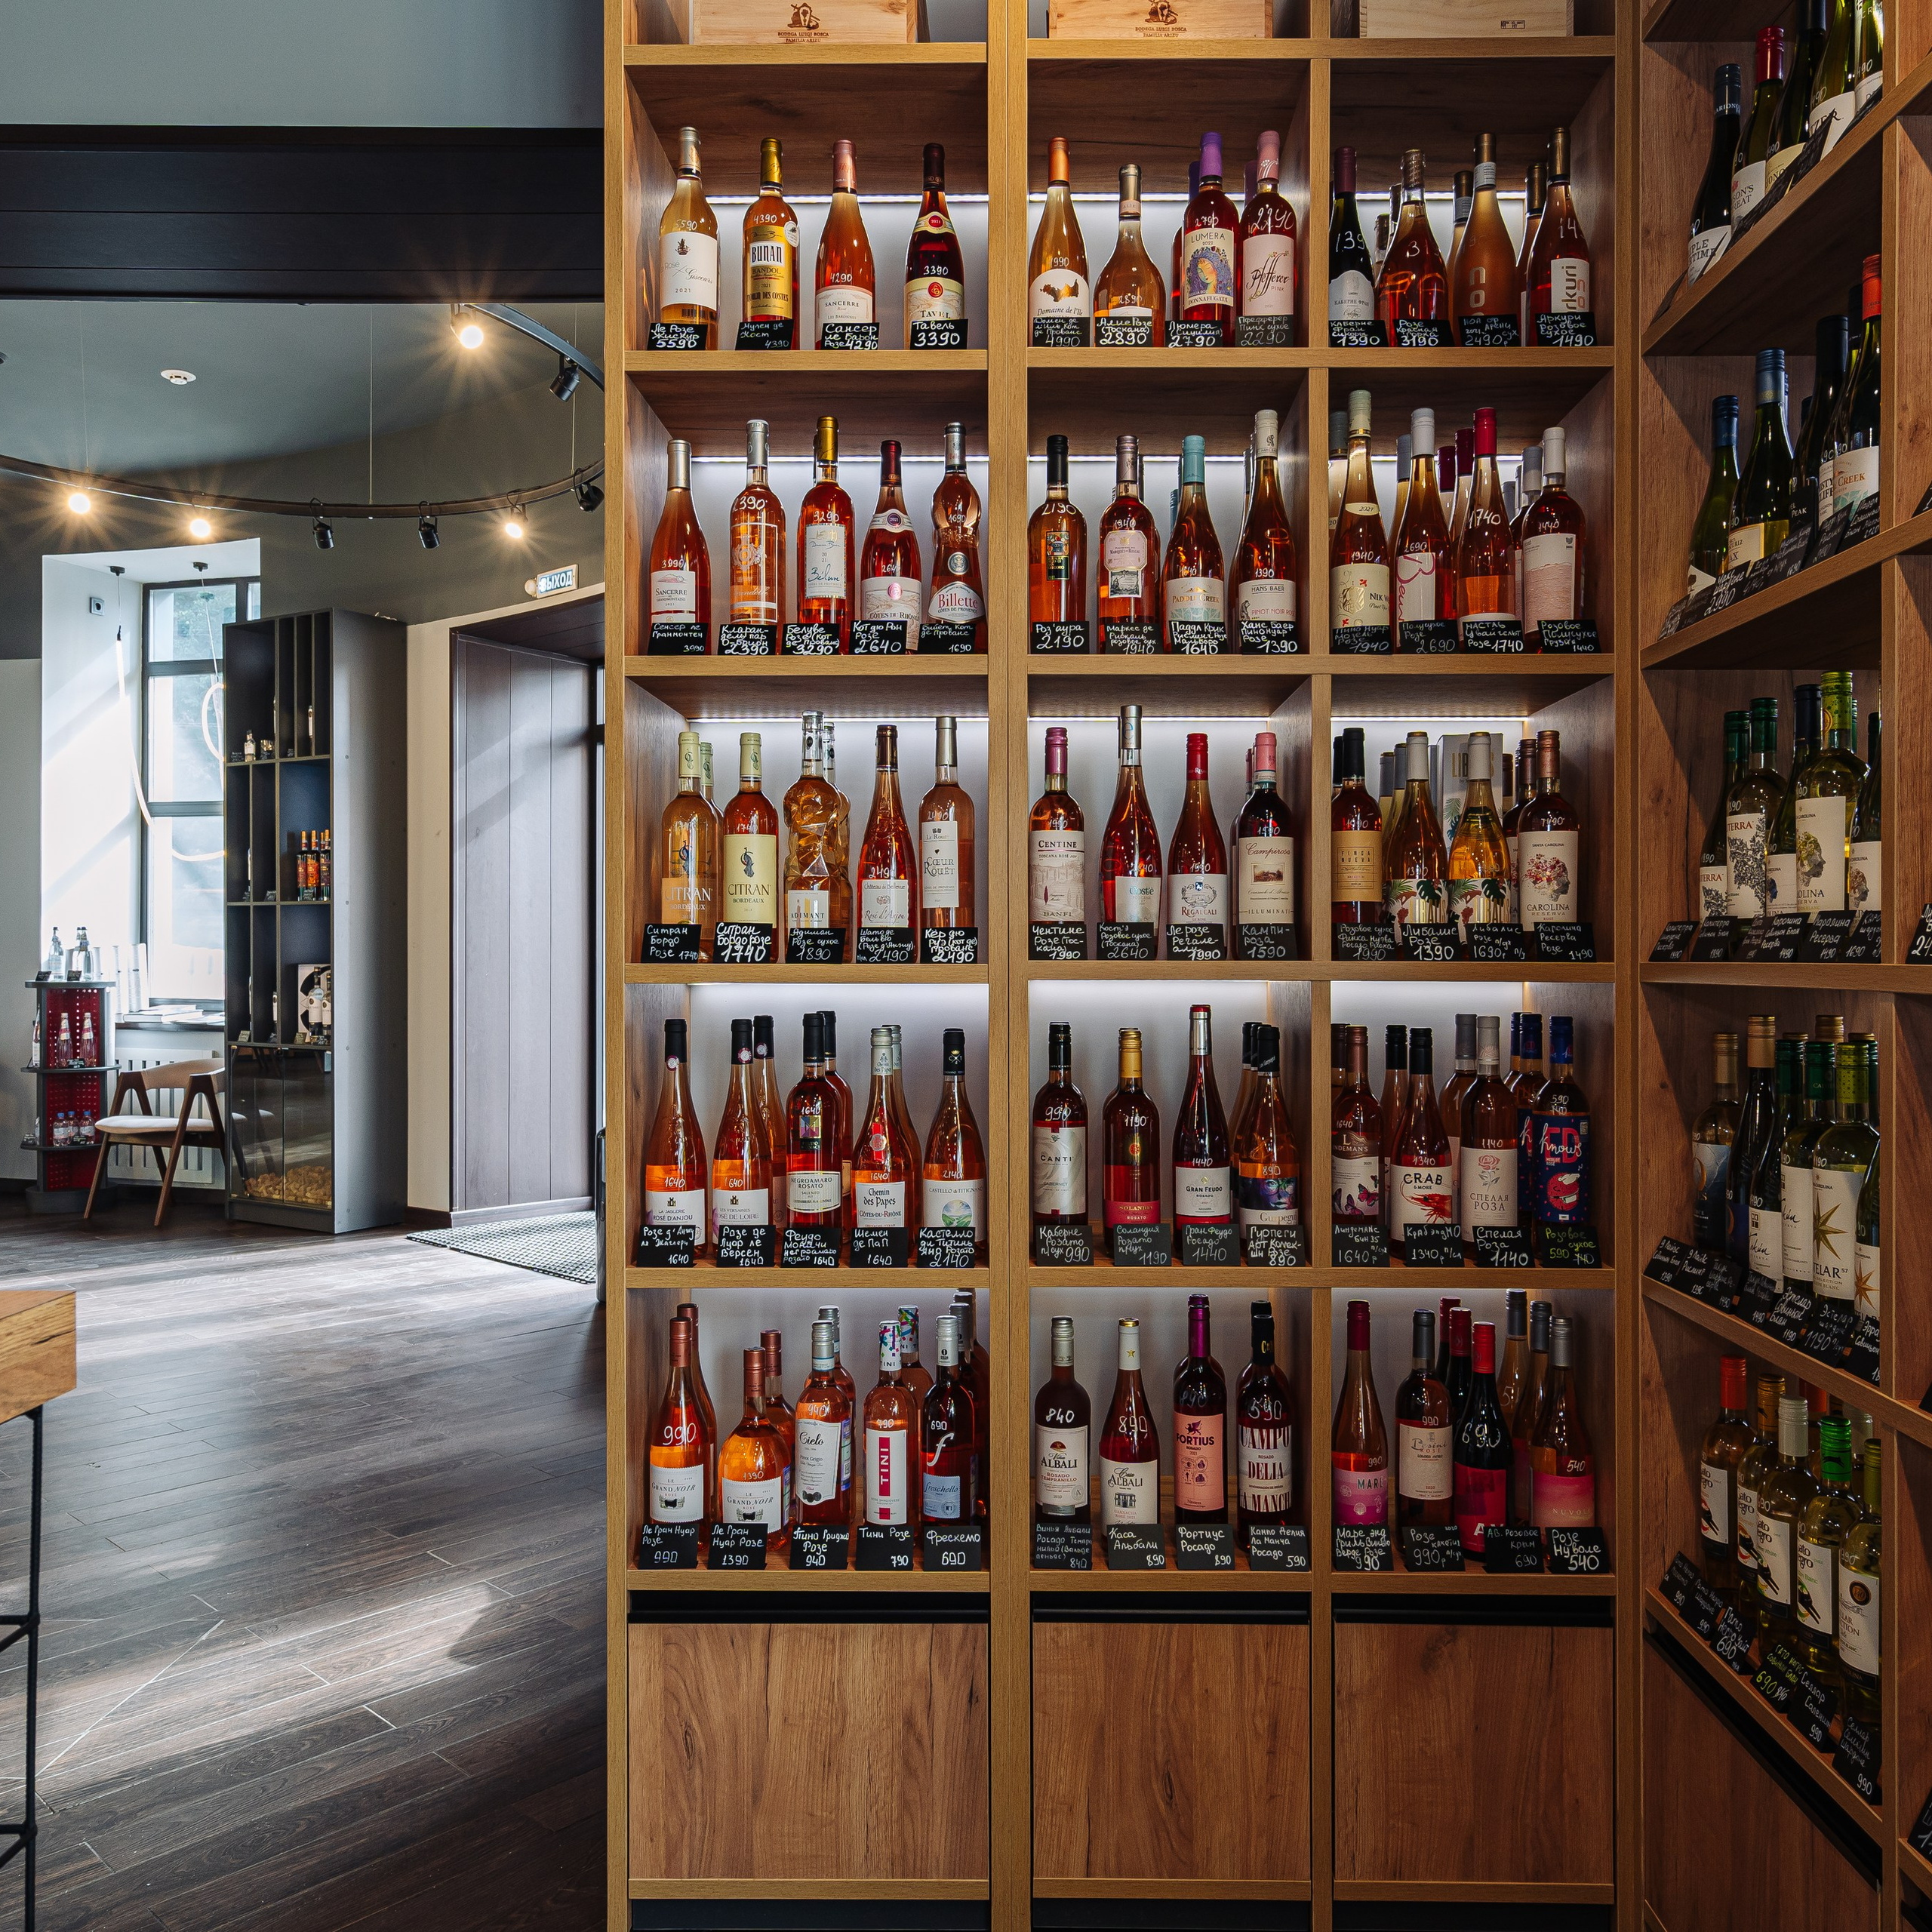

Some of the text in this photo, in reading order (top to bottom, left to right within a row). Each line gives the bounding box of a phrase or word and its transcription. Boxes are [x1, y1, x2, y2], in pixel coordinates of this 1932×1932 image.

[1190, 232, 1226, 242] LUMERA
[752, 245, 783, 263] BUNAN
[752, 267, 782, 275] BANDOL
[923, 265, 949, 275] 3390
[1187, 297, 1229, 306] DONNAFUGATA
[920, 309, 951, 318] TAVEL
[825, 322, 878, 334] Сансер
[912, 321, 955, 331] Тавель
[1168, 321, 1217, 330] Люмера
[1398, 320, 1424, 328] Розе
[913, 331, 960, 347] 3390
[1045, 337, 1081, 348] 4990
[1099, 333, 1148, 346] 2890
[1552, 334, 1594, 347] 1490
[1837, 472, 1866, 487] CREEK
[1791, 506, 1807, 518] PEAK
[1254, 568, 1275, 579] 1390
[539, 571, 573, 592] ВЫХОД
[656, 588, 688, 596] SANCERRE
[937, 592, 978, 608] Billette
[1198, 594, 1220, 604] CREEK
[1703, 587, 1737, 617] 2990
[1491, 638, 1524, 653] 1740
[1038, 839, 1078, 849] CENTINE
[1245, 841, 1291, 857] Campirosa
[927, 856, 955, 867] CŒUR
[665, 887, 713, 903] CITRAN
[728, 882, 771, 897] CITRAN
[1181, 906, 1218, 917] REGALEALI
[1526, 903, 1571, 912] CAROLINA
[647, 924, 688, 935] Ситран
[716, 924, 761, 936] Ситран
[1032, 924, 1085, 935] Чентине
[1402, 924, 1459, 937] Либалис
[650, 937, 680, 946] Бордо
[1408, 937, 1441, 948] Розе
[796, 947, 832, 961] 1890
[869, 949, 909, 962] 2490
[931, 951, 974, 963] 2490
[1107, 949, 1149, 959] 2640
[1247, 946, 1286, 958] 1590
[1779, 949, 1794, 958] 1490
[1820, 948, 1836, 958] 1490
[1845, 946, 1866, 957] 1690
[1044, 1105, 1072, 1121] 990
[1040, 1154, 1072, 1163] CANTI
[664, 1177, 686, 1188] 1640
[790, 1175, 834, 1186] NEGROAMARO
[1402, 1173, 1443, 1186] CRAB
[798, 1183, 824, 1191] ROSATO
[868, 1186, 891, 1198] Chemin
[863, 1196, 897, 1209] des Papes
[1469, 1192, 1509, 1203] СПЕЛАЯ
[1473, 1201, 1506, 1212] РОЗА
[667, 1213, 694, 1222] D'ANJOU
[859, 1209, 902, 1219] CÔTES-DU-RHÔNE
[1039, 1226, 1083, 1239] Каберне
[1208, 1227, 1232, 1238] Феудо
[1476, 1226, 1522, 1239] Спелая
[1476, 1238, 1509, 1252] Роза
[867, 1254, 893, 1266] 1640
[1783, 1329, 1797, 1342] 1190
[1804, 1329, 1832, 1351] 1190
[1045, 1407, 1075, 1423] 840
[931, 1420, 948, 1431] 690
[1118, 1416, 1149, 1434] 890
[663, 1423, 697, 1446] 990
[798, 1430, 823, 1444] Cielo
[1176, 1432, 1215, 1445] FORTIUS
[1239, 1426, 1289, 1451] CAMPO
[879, 1447, 888, 1486] TINI
[1040, 1457, 1078, 1469] ALBALI
[1566, 1459, 1586, 1472] 540
[1247, 1460, 1284, 1480] DELIA
[1109, 1475, 1143, 1487] ALBALI
[1356, 1477, 1384, 1489] MARE
[651, 1483, 697, 1492] GRAND NOIR
[924, 1482, 959, 1496] freschello
[727, 1496, 774, 1506] GRAND NOIR
[657, 1525, 673, 1537] Гран
[675, 1525, 696, 1537] Нуар
[727, 1525, 749, 1537] Гран
[858, 1527, 911, 1541] Тини Розе
[1109, 1527, 1137, 1538] Каса
[1177, 1526, 1226, 1540] Фортиус
[642, 1537, 663, 1546] Розе
[712, 1537, 764, 1548] Нуар Розе
[1551, 1529, 1580, 1546] Розе
[1180, 1540, 1216, 1554] Росадо
[654, 1550, 678, 1564] 990
[721, 1555, 749, 1566] 1390
[891, 1555, 909, 1567] 790
[1146, 1554, 1165, 1566] 890
[1214, 1555, 1232, 1567] 890
[1285, 1555, 1306, 1567] 590
[1567, 1554, 1601, 1571] 540
[1673, 1590, 1686, 1607] 990
[1717, 1635, 1737, 1660] 690
[1756, 1670, 1777, 1695] 690
[1809, 1724, 1823, 1743] 990
[1857, 1773, 1873, 1795] 990
